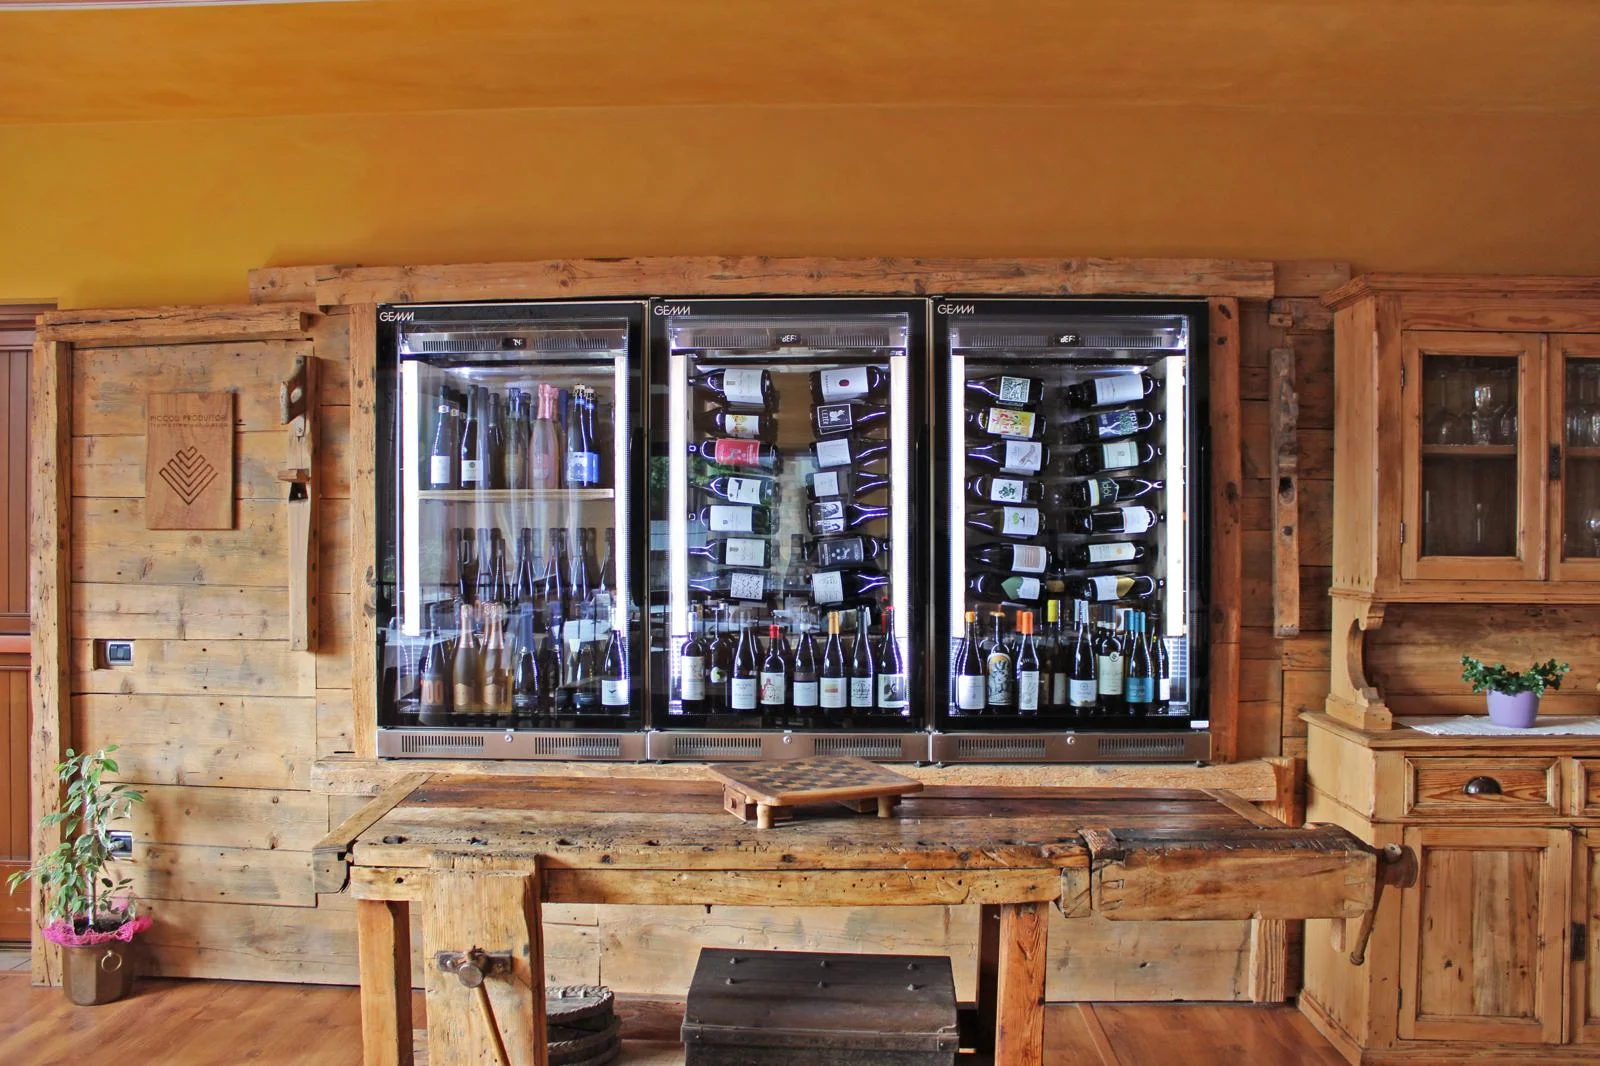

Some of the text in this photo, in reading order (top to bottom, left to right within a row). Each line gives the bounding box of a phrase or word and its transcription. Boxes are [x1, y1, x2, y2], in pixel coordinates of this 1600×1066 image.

[653, 305, 691, 316] GEMM
[937, 304, 975, 315] GEMM
[379, 311, 415, 322] GEMM
